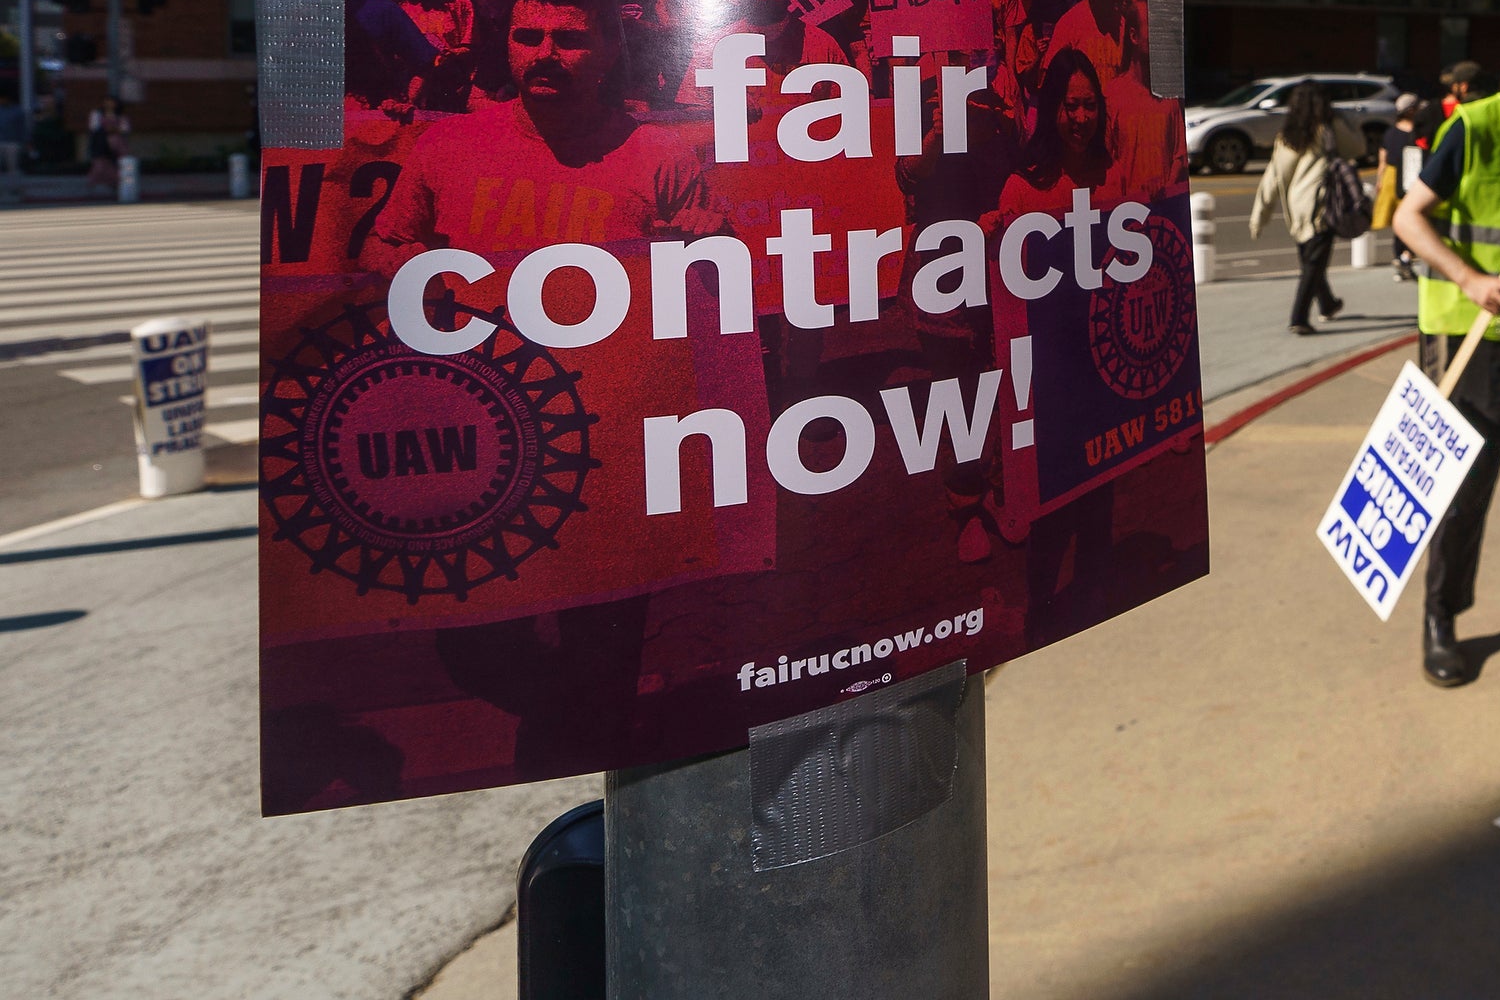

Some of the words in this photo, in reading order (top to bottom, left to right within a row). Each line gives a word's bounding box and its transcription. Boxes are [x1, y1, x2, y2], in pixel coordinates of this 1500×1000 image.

[695, 33, 987, 163] fair
[469, 178, 614, 242] FAIR
[388, 188, 1154, 355] contracts
[1128, 288, 1168, 342] UAW
[357, 425, 477, 480] UAW
[644, 335, 1035, 516] now!
[1084, 415, 1146, 467] UAW
[1397, 413, 1445, 471] LABOR
[1400, 379, 1470, 461] PRACTICE
[1355, 451, 1427, 545] STRIKE
[1384, 431, 1436, 497] UNFAIR
[1327, 519, 1389, 602] UAW
[1356, 500, 1393, 550] ON
[737, 607, 984, 691] fairucnow.org
